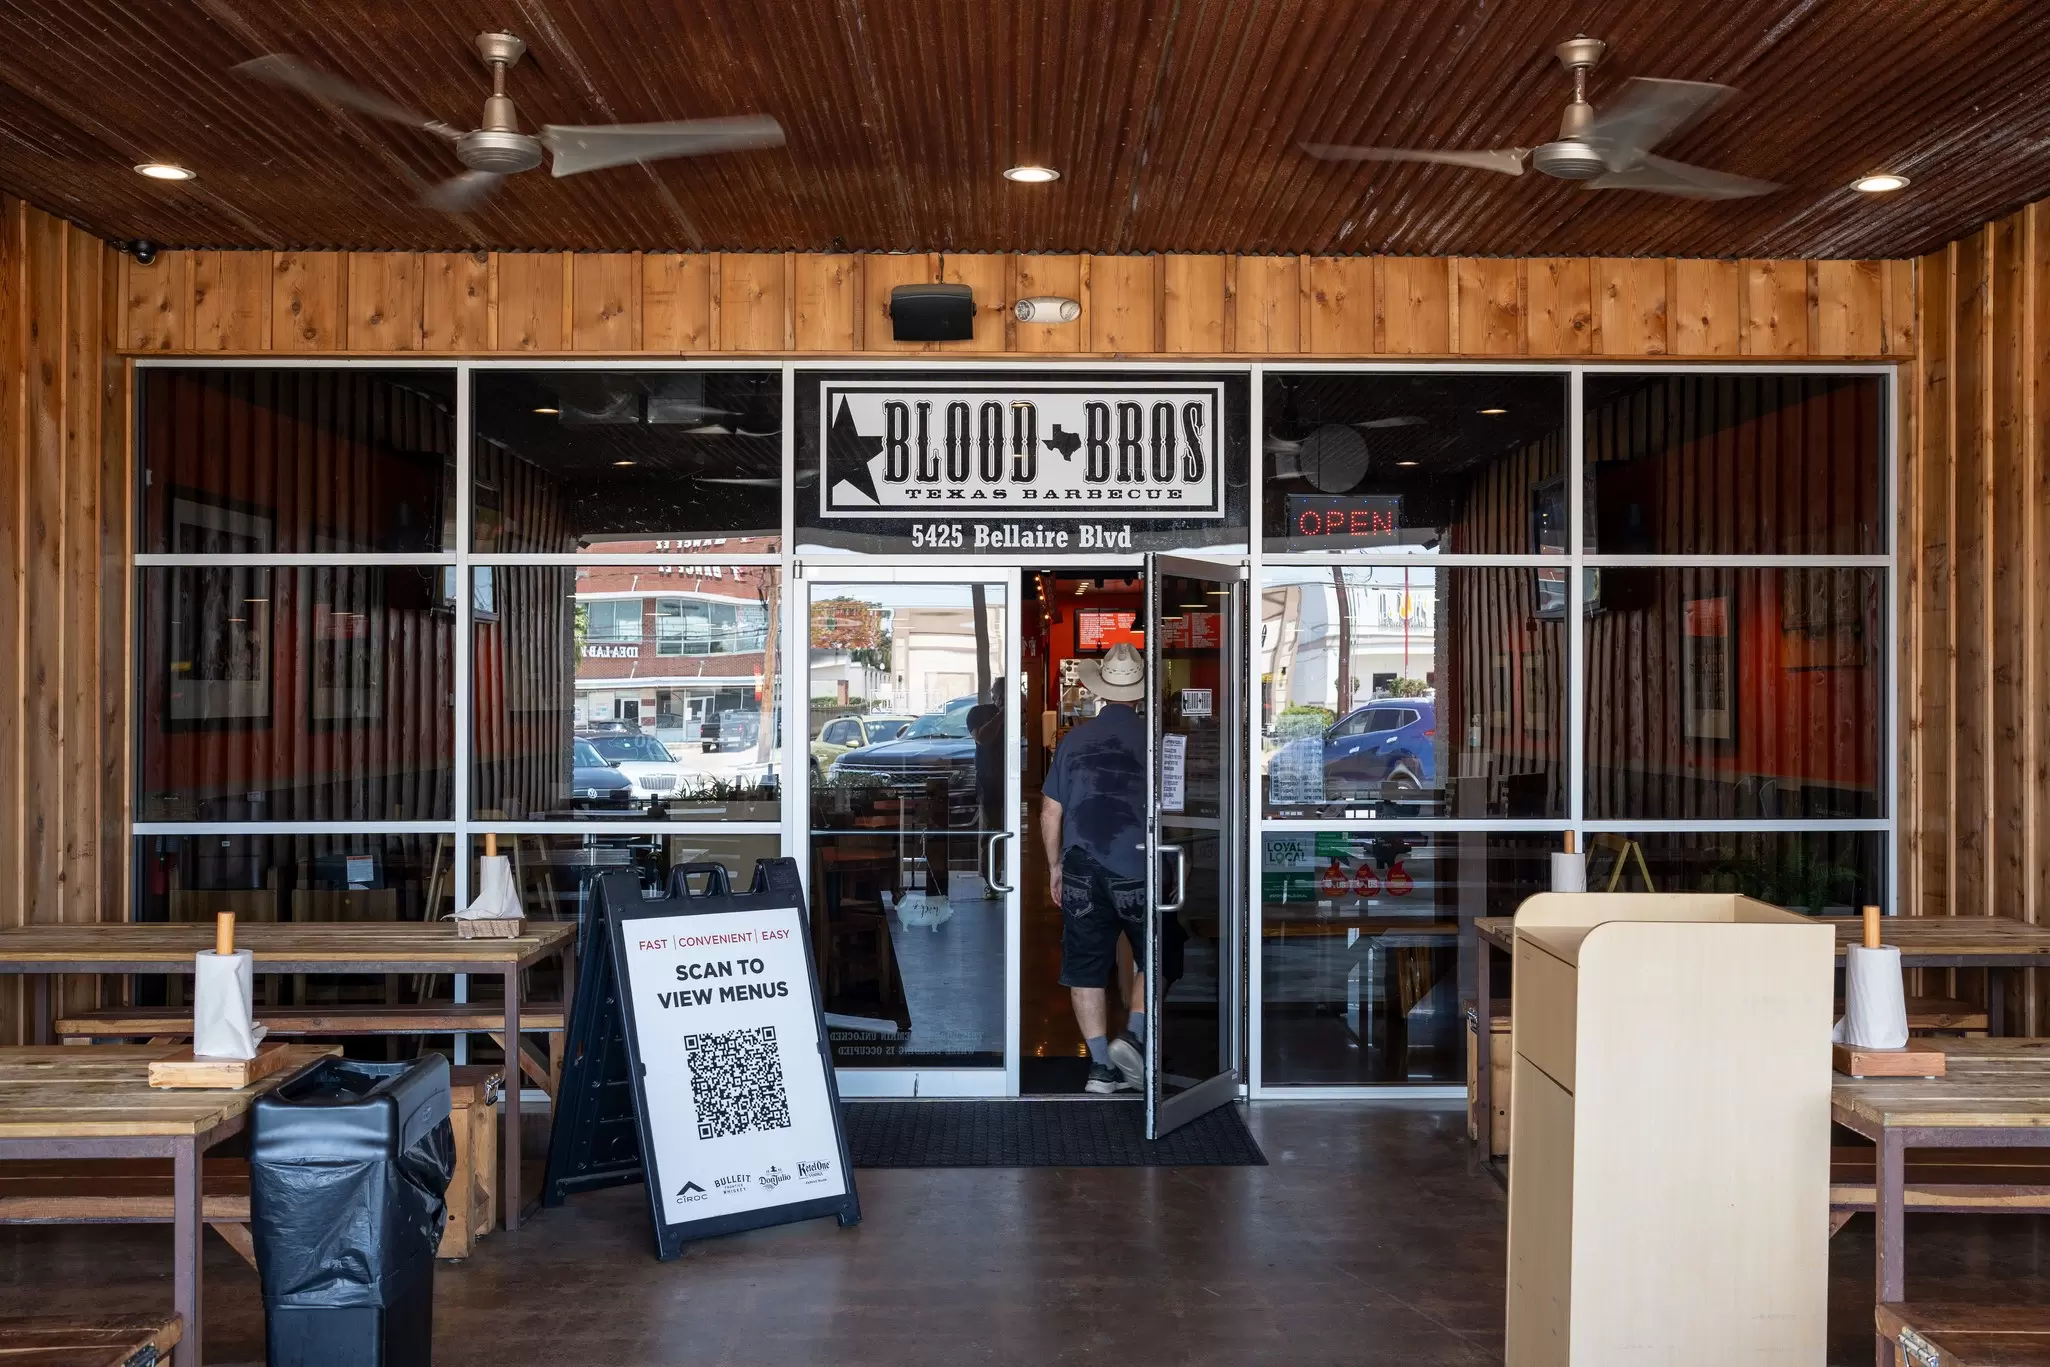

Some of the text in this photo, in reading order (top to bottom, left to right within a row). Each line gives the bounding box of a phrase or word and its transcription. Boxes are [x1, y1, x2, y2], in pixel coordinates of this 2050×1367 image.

[882, 398, 1207, 485] BLOOD BROS
[905, 489, 1184, 499] TEXAS BARBECUE
[1299, 510, 1392, 537] OPEN
[911, 523, 1132, 549] 5425 Bellaire Blvd
[1267, 842, 1303, 852] LOYAL
[1269, 852, 1306, 863] LOCAL
[638, 929, 791, 951] FAST CONVENIENT EASY
[675, 958, 765, 981] SCAN TO
[657, 981, 789, 1009] VIEW MENUS
[714, 1174, 752, 1188] BULLEIT
[723, 1187, 746, 1195] WHISKEY
